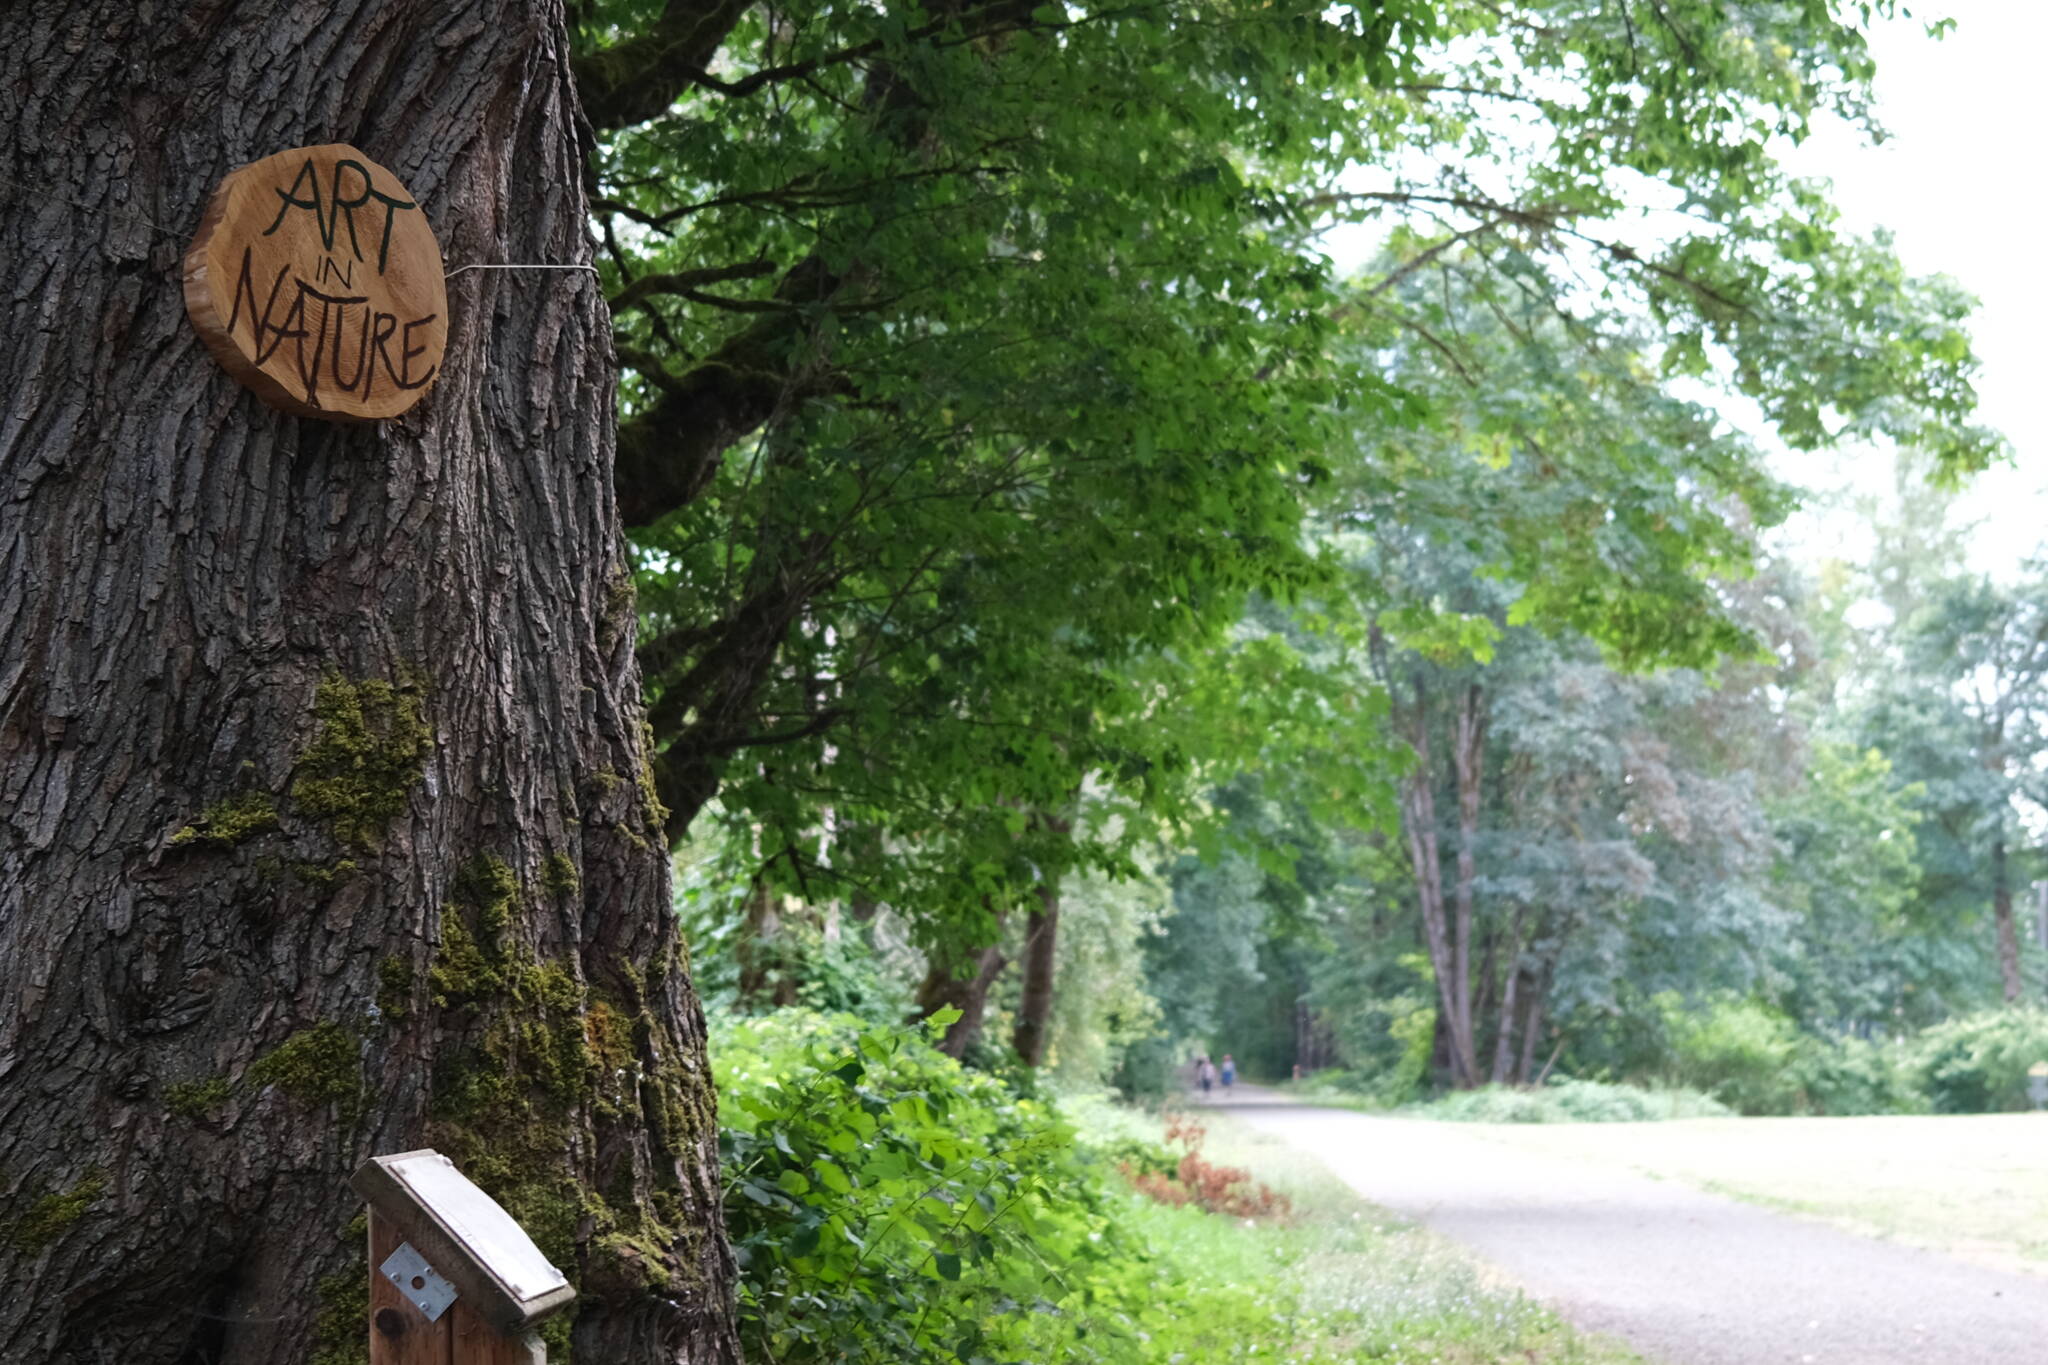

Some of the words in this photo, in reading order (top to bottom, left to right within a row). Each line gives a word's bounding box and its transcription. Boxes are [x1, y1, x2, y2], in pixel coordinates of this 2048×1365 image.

[262, 157, 416, 276] ART
[315, 255, 352, 289] IN
[227, 246, 437, 408] NATURE
